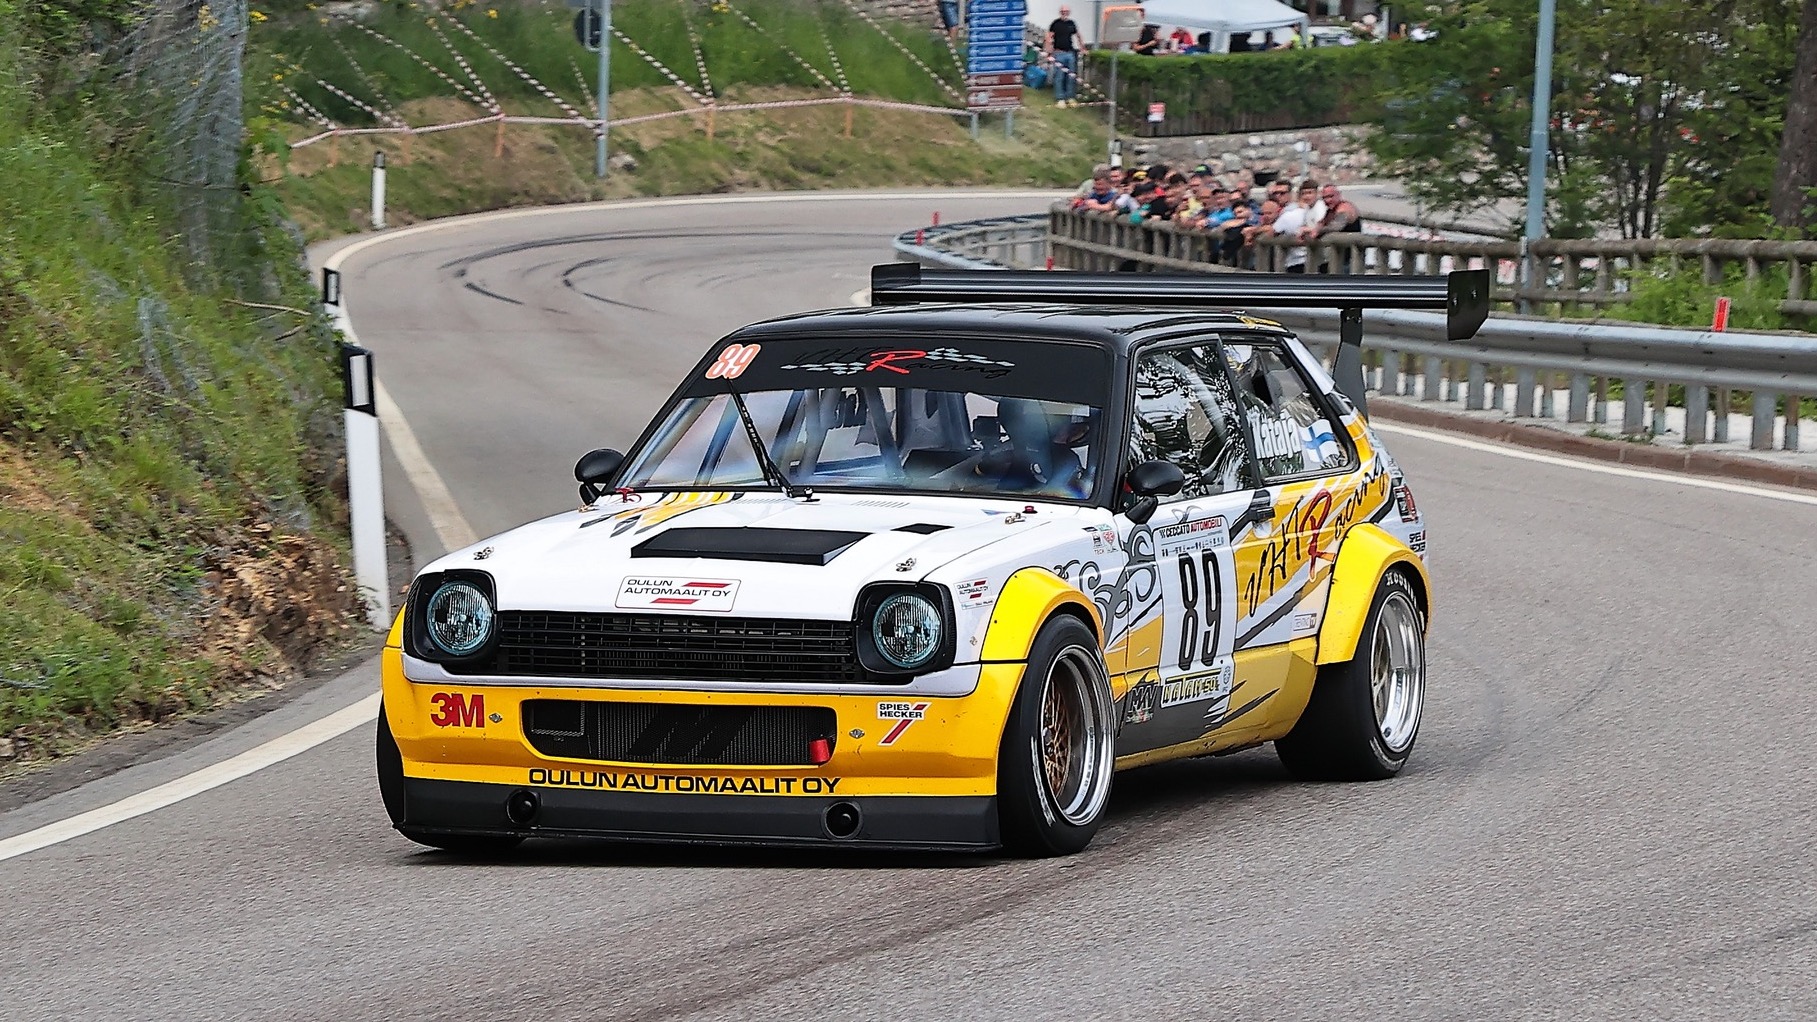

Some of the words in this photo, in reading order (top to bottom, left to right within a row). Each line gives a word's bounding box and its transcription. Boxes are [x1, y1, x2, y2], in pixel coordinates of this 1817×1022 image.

[705, 344, 762, 379] 89
[1166, 524, 1190, 538] CECCATO
[624, 587, 710, 596] AUTOMAALIT
[627, 579, 673, 587] OULUN
[1178, 548, 1222, 671] 89
[430, 692, 485, 729] 3M
[528, 768, 619, 789] OULUN
[622, 772, 797, 793] AUTOMAALIT
[802, 776, 843, 795] OY
